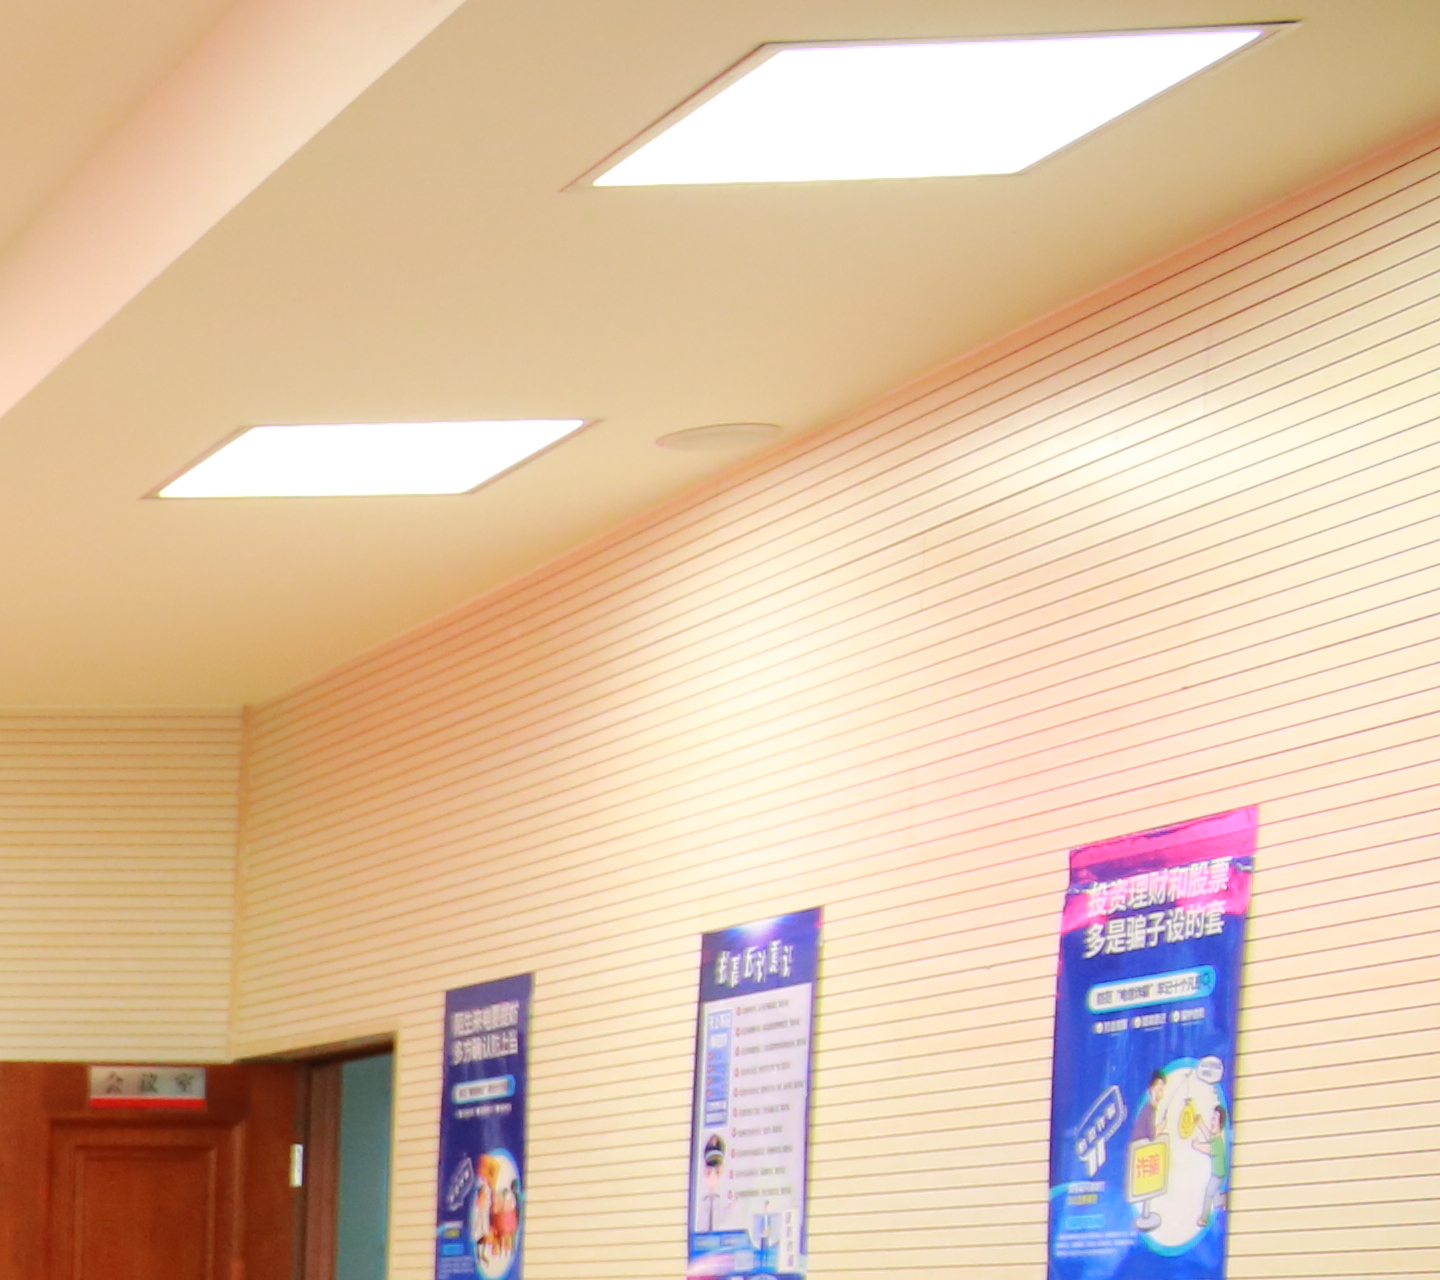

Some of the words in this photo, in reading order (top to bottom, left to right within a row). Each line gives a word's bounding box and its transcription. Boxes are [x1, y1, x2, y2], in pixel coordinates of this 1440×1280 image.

[1085, 856, 1232, 917] 投资理财和股票
[1083, 900, 1226, 958] 多是骗子设的套
